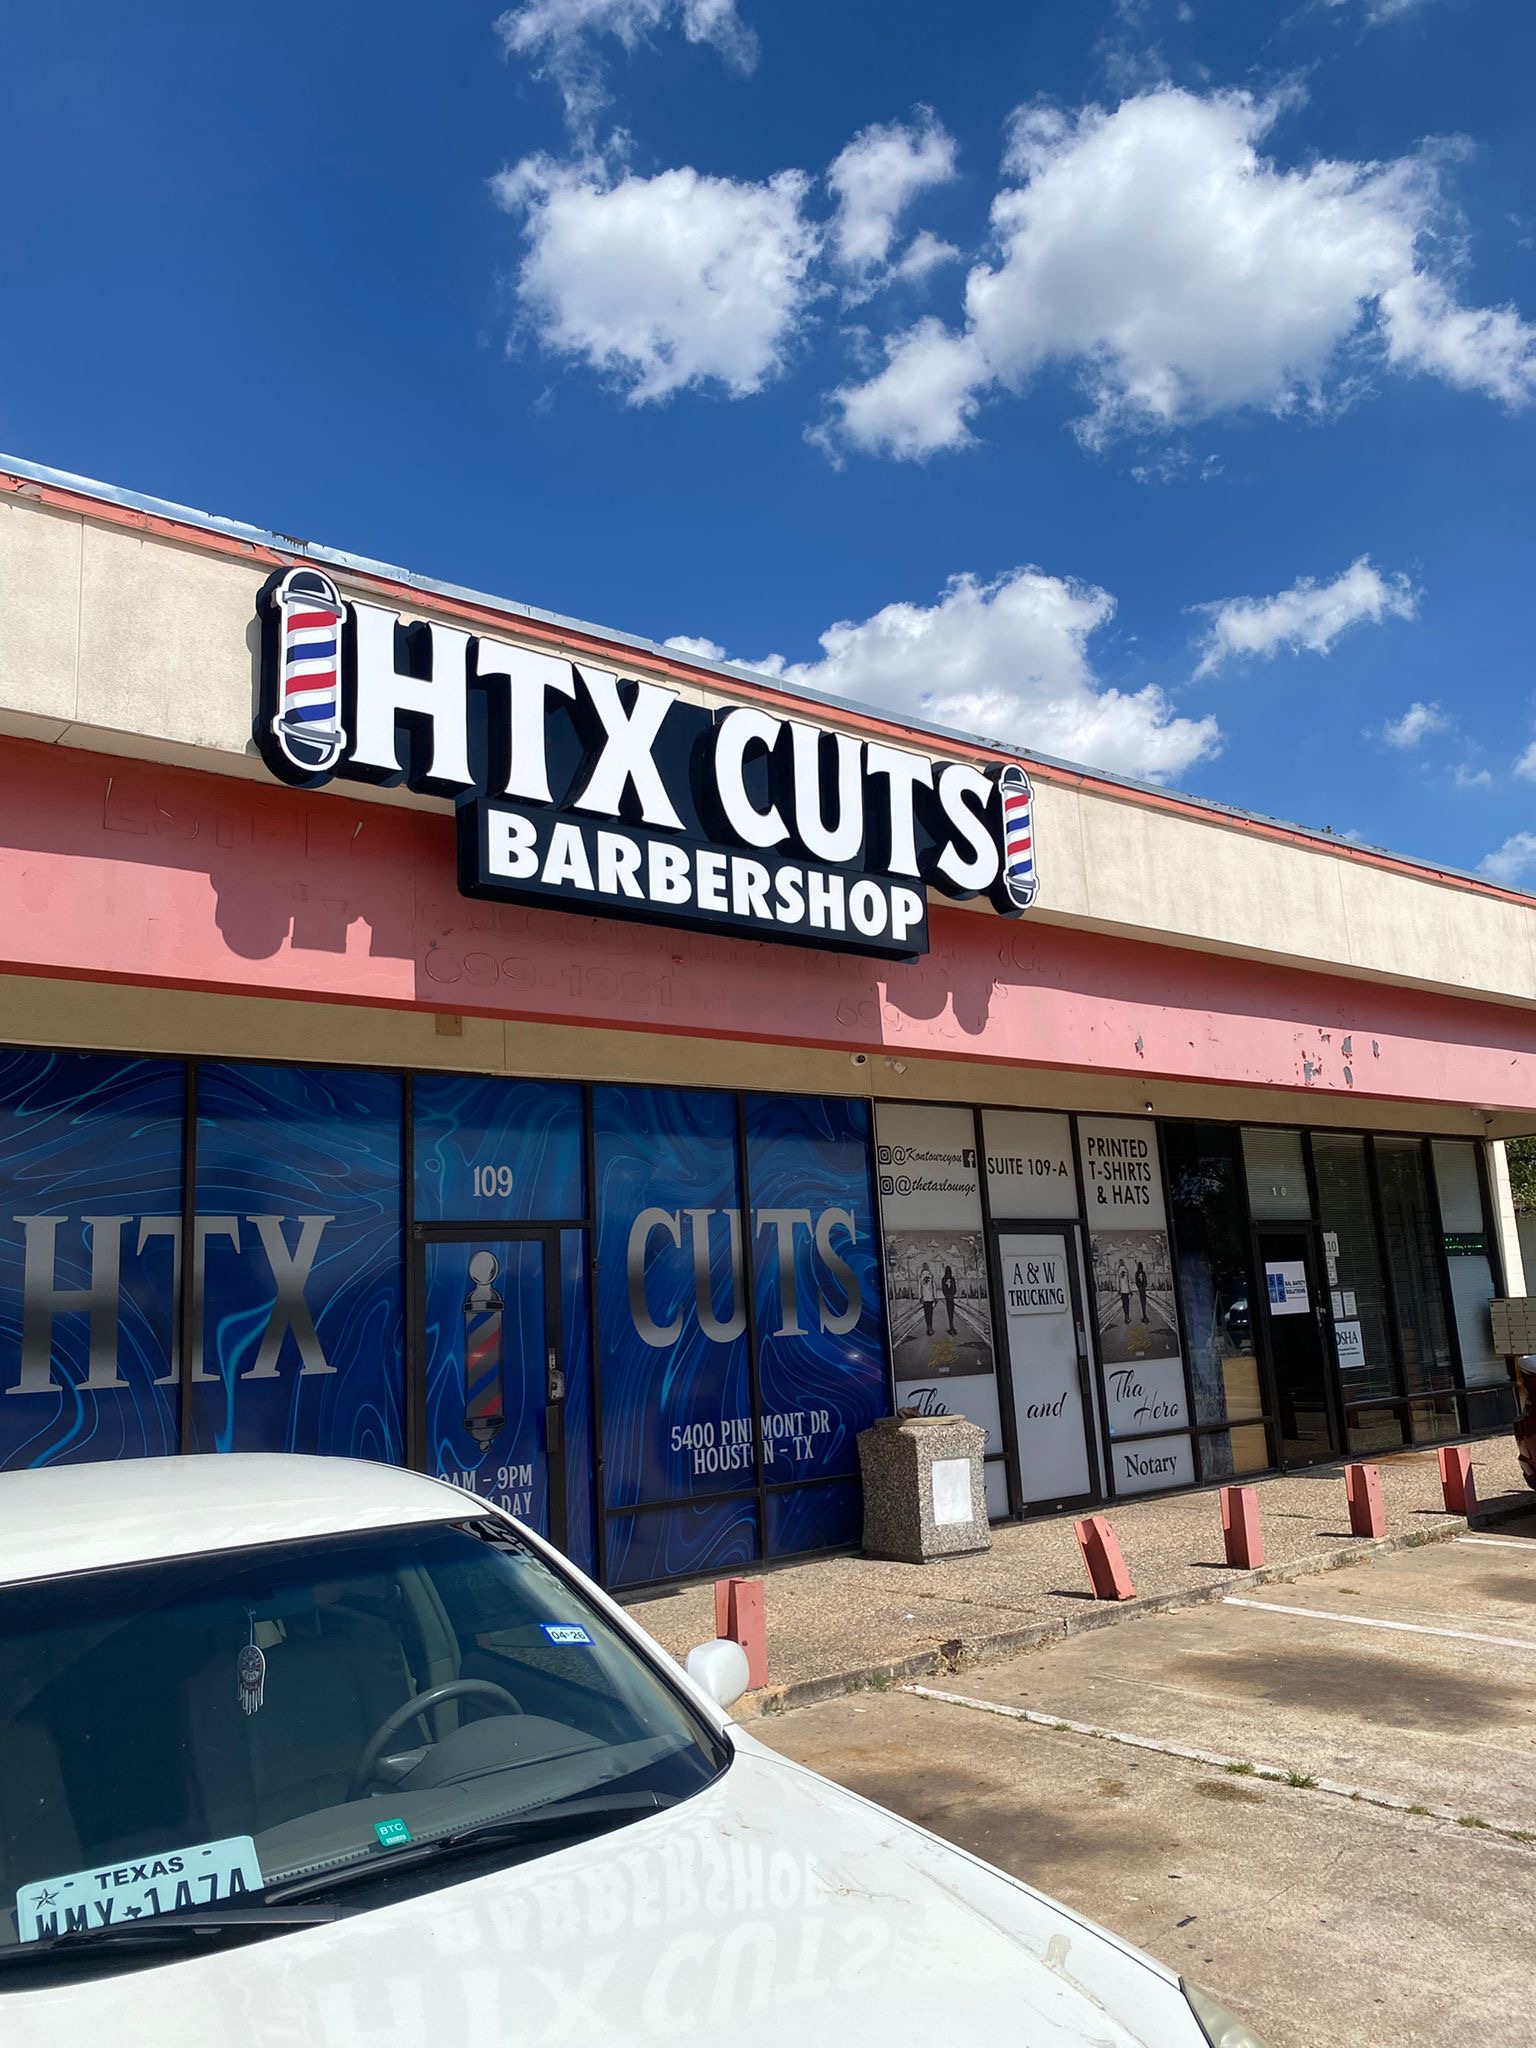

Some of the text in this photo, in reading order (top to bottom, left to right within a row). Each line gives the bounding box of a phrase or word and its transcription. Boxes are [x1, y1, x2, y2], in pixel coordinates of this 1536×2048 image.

[349, 601, 687, 830] HTX
[714, 707, 1000, 890] CUTS
[487, 809, 924, 941] BARBERSHOP
[1087, 1137, 1148, 1158] PRINTED
[987, 1157, 1068, 1177] SUITE 109-A
[1089, 1161, 1151, 1181] T-SHIRTS
[473, 1165, 513, 1197] 109
[1097, 1185, 1150, 1205] & HATS
[627, 1207, 862, 1348] CUTS
[1013, 1262, 1055, 1285] A & W
[5, 1215, 338, 1395] HTX
[1008, 1288, 1065, 1307] TRUCKING
[1109, 1370, 1145, 1402] Tha
[1027, 1392, 1067, 1418] and
[1134, 1390, 1179, 1426] Hero
[671, 1422, 715, 1452] 5400
[811, 1410, 832, 1434] DR
[793, 1435, 815, 1461] TX
[497, 1464, 532, 1490] 9PM
[1124, 1453, 1177, 1478] Notary
[501, 1492, 532, 1516] DAY
[379, 1823, 403, 1835] BTC
[94, 1856, 184, 1890] TEXAS
